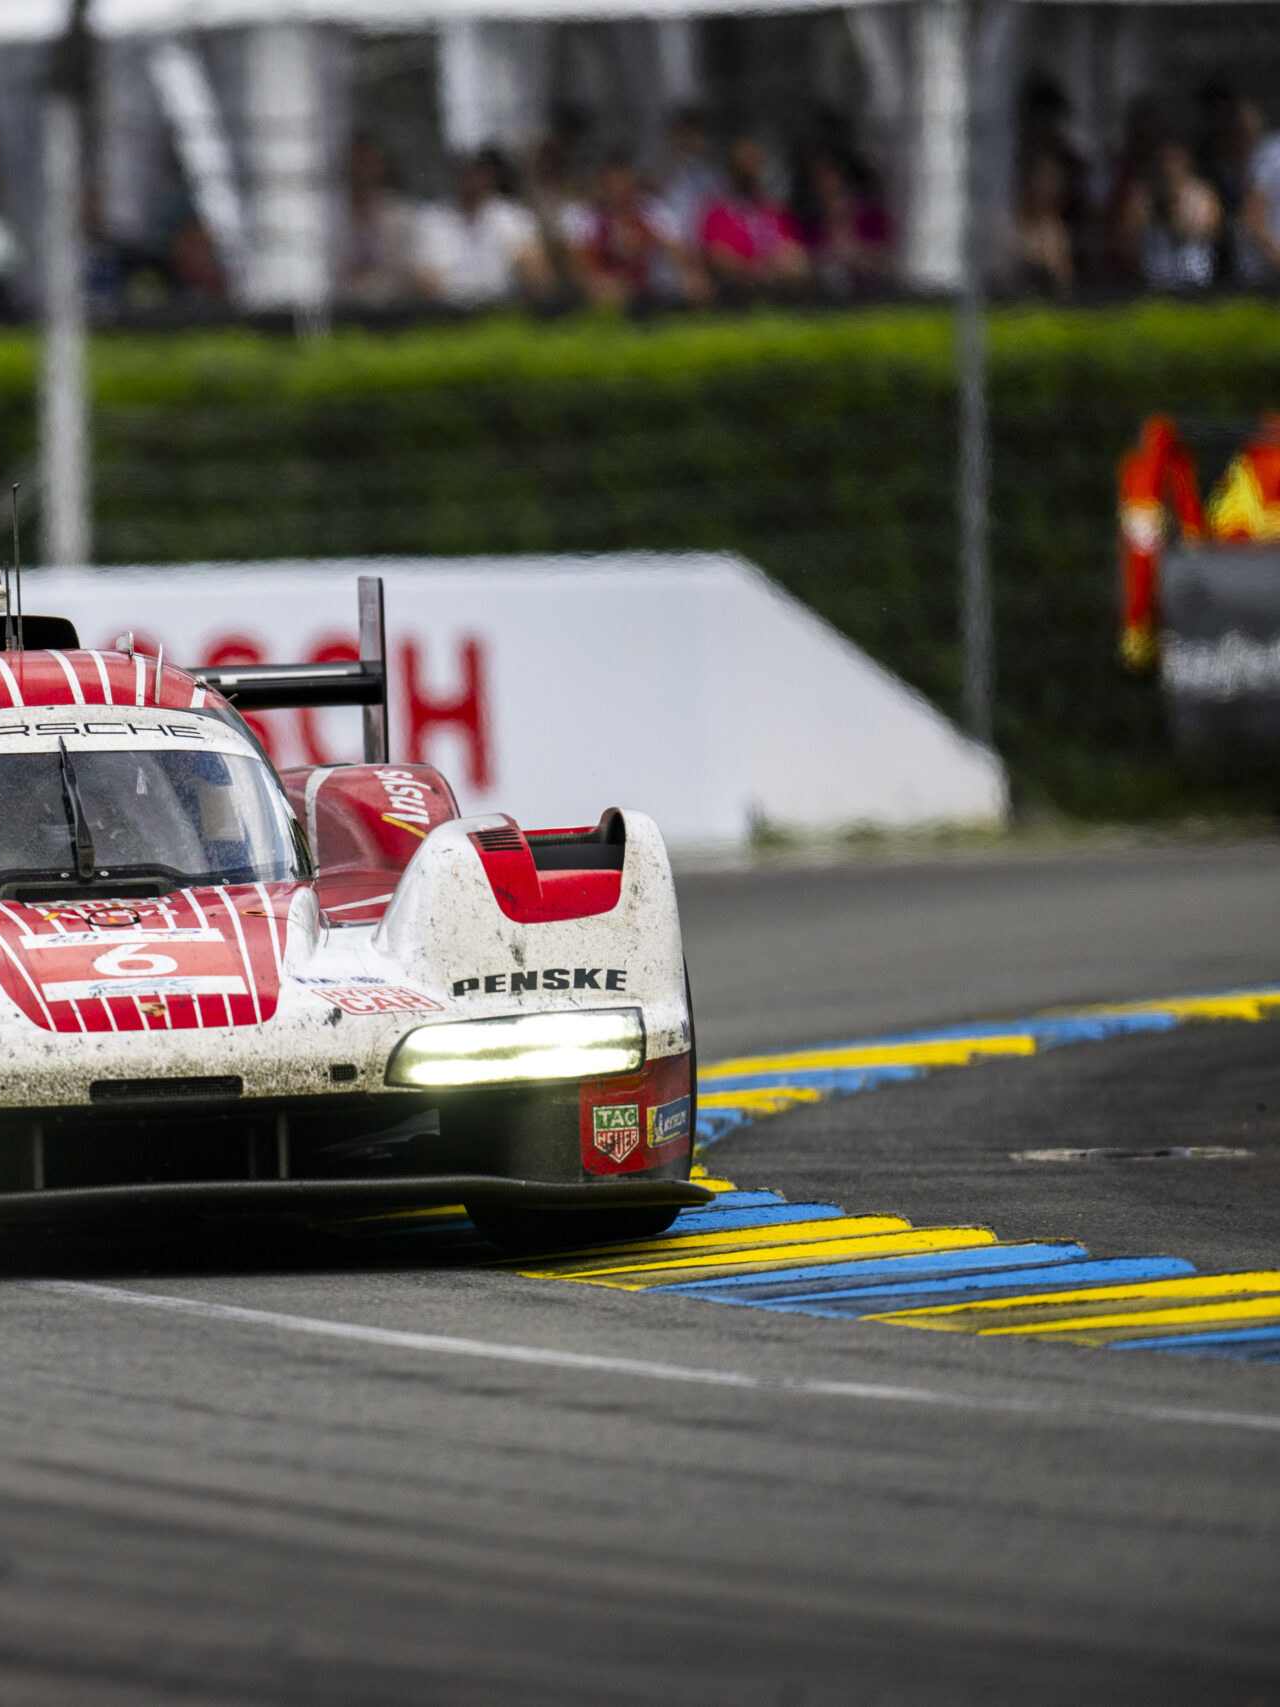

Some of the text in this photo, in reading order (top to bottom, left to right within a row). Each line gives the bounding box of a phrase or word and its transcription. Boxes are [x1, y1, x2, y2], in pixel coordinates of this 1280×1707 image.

[93, 943, 179, 977] 6
[452, 968, 627, 997] PENSKE
[321, 987, 411, 999] HYPER
[338, 996, 431, 1012] CAR
[597, 1108, 637, 1127] TAG
